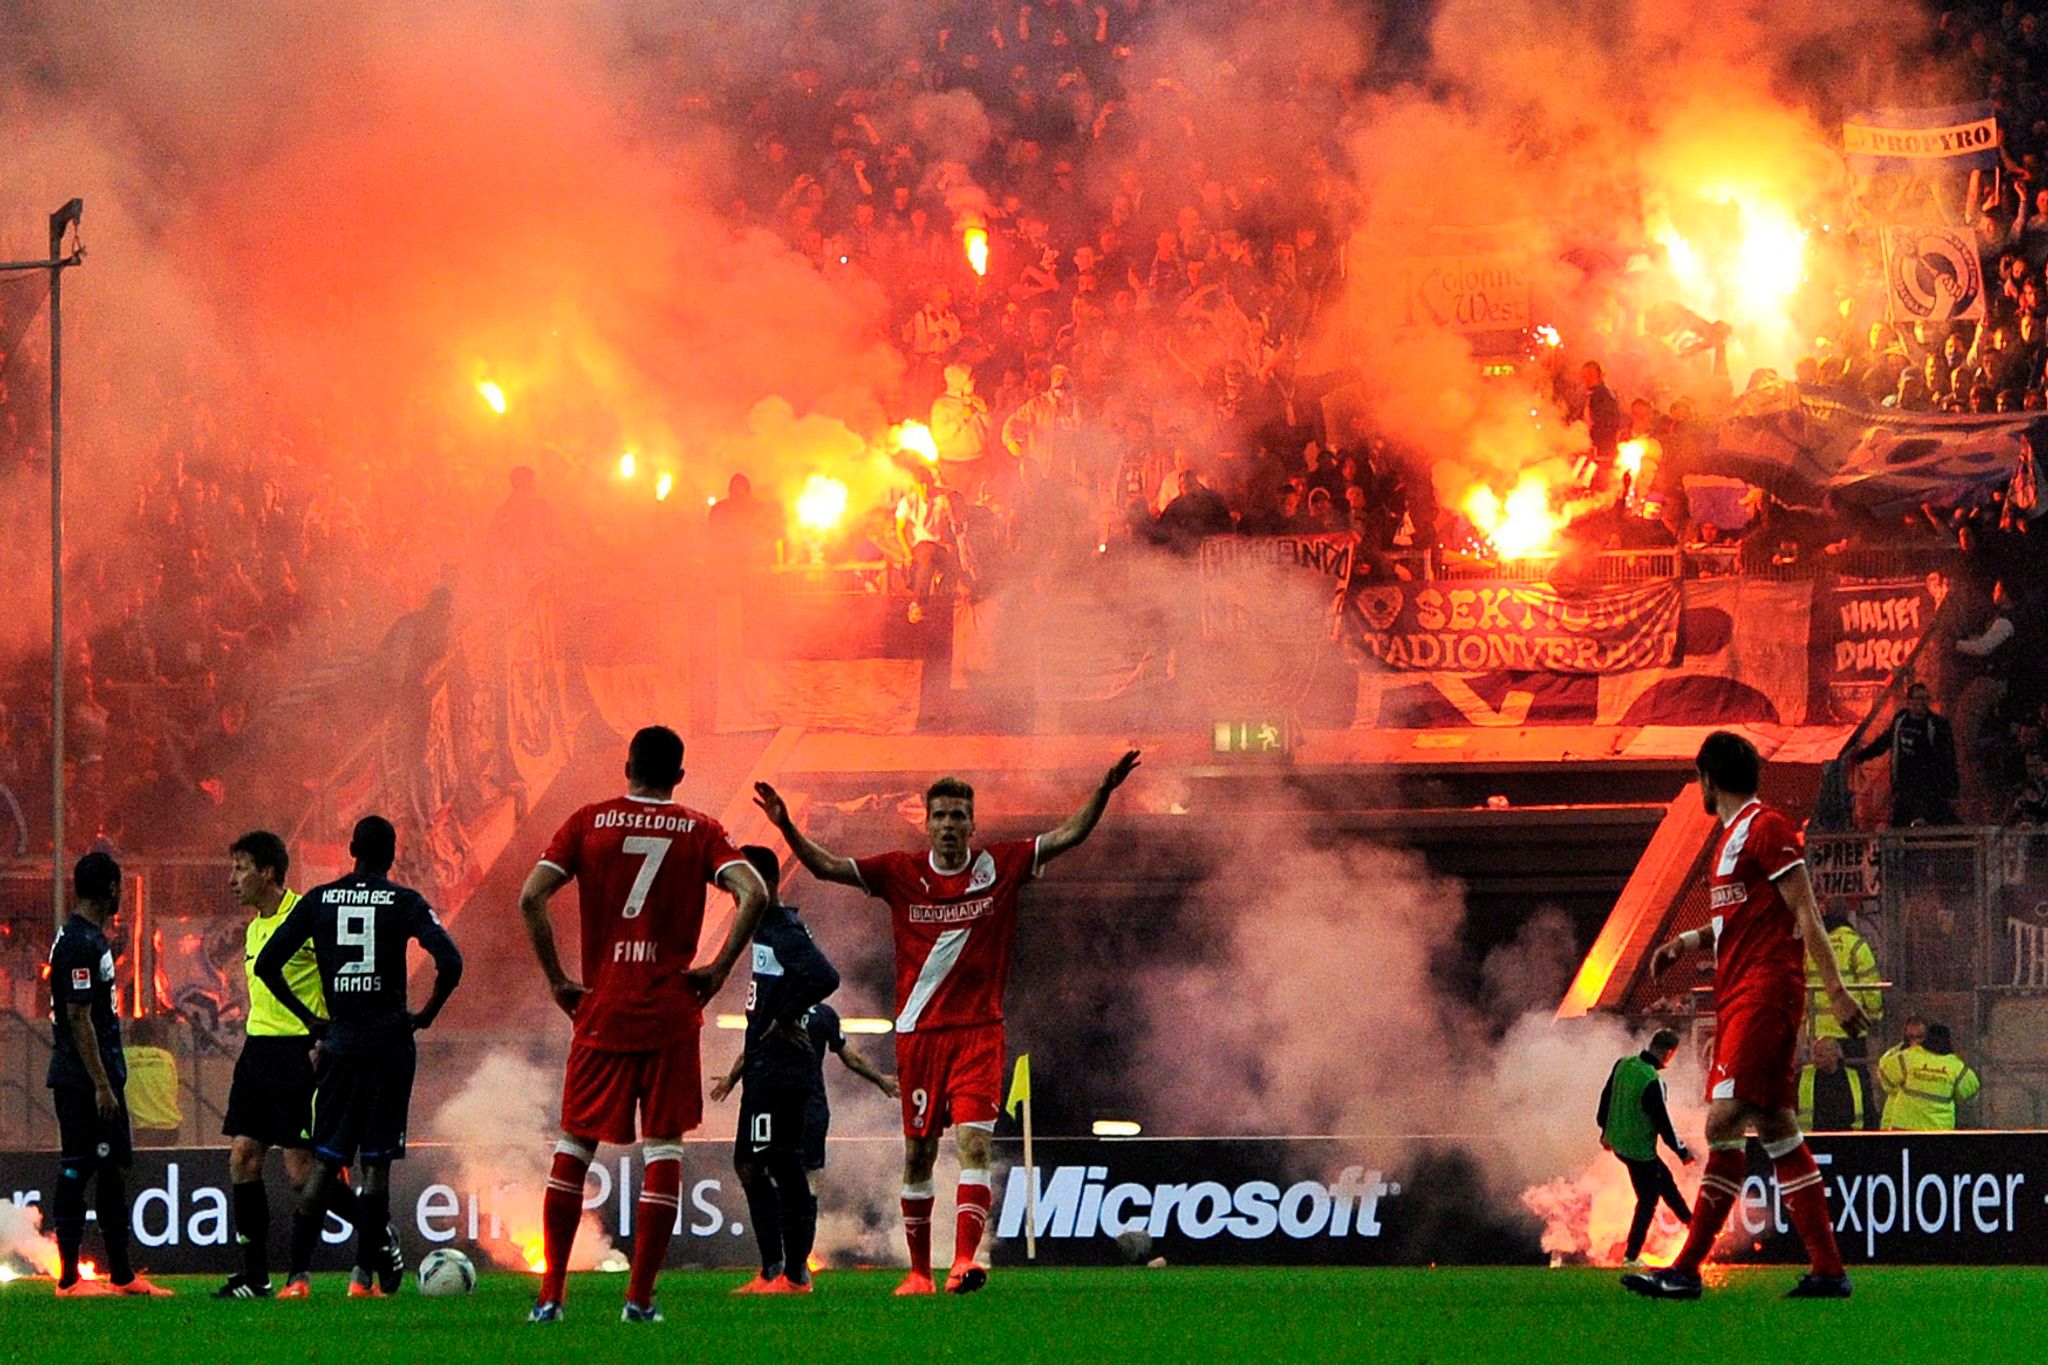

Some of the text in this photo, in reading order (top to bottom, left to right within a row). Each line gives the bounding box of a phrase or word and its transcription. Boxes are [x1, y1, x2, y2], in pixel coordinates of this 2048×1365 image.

[594, 809, 697, 833] DÜSSELDORF
[621, 835, 673, 919] 7
[322, 889, 396, 905] HERTHA BSC
[336, 905, 376, 974] 9
[613, 940, 658, 963] FINK
[911, 1088, 928, 1115] 9
[997, 1165, 1387, 1240] Microsoft
